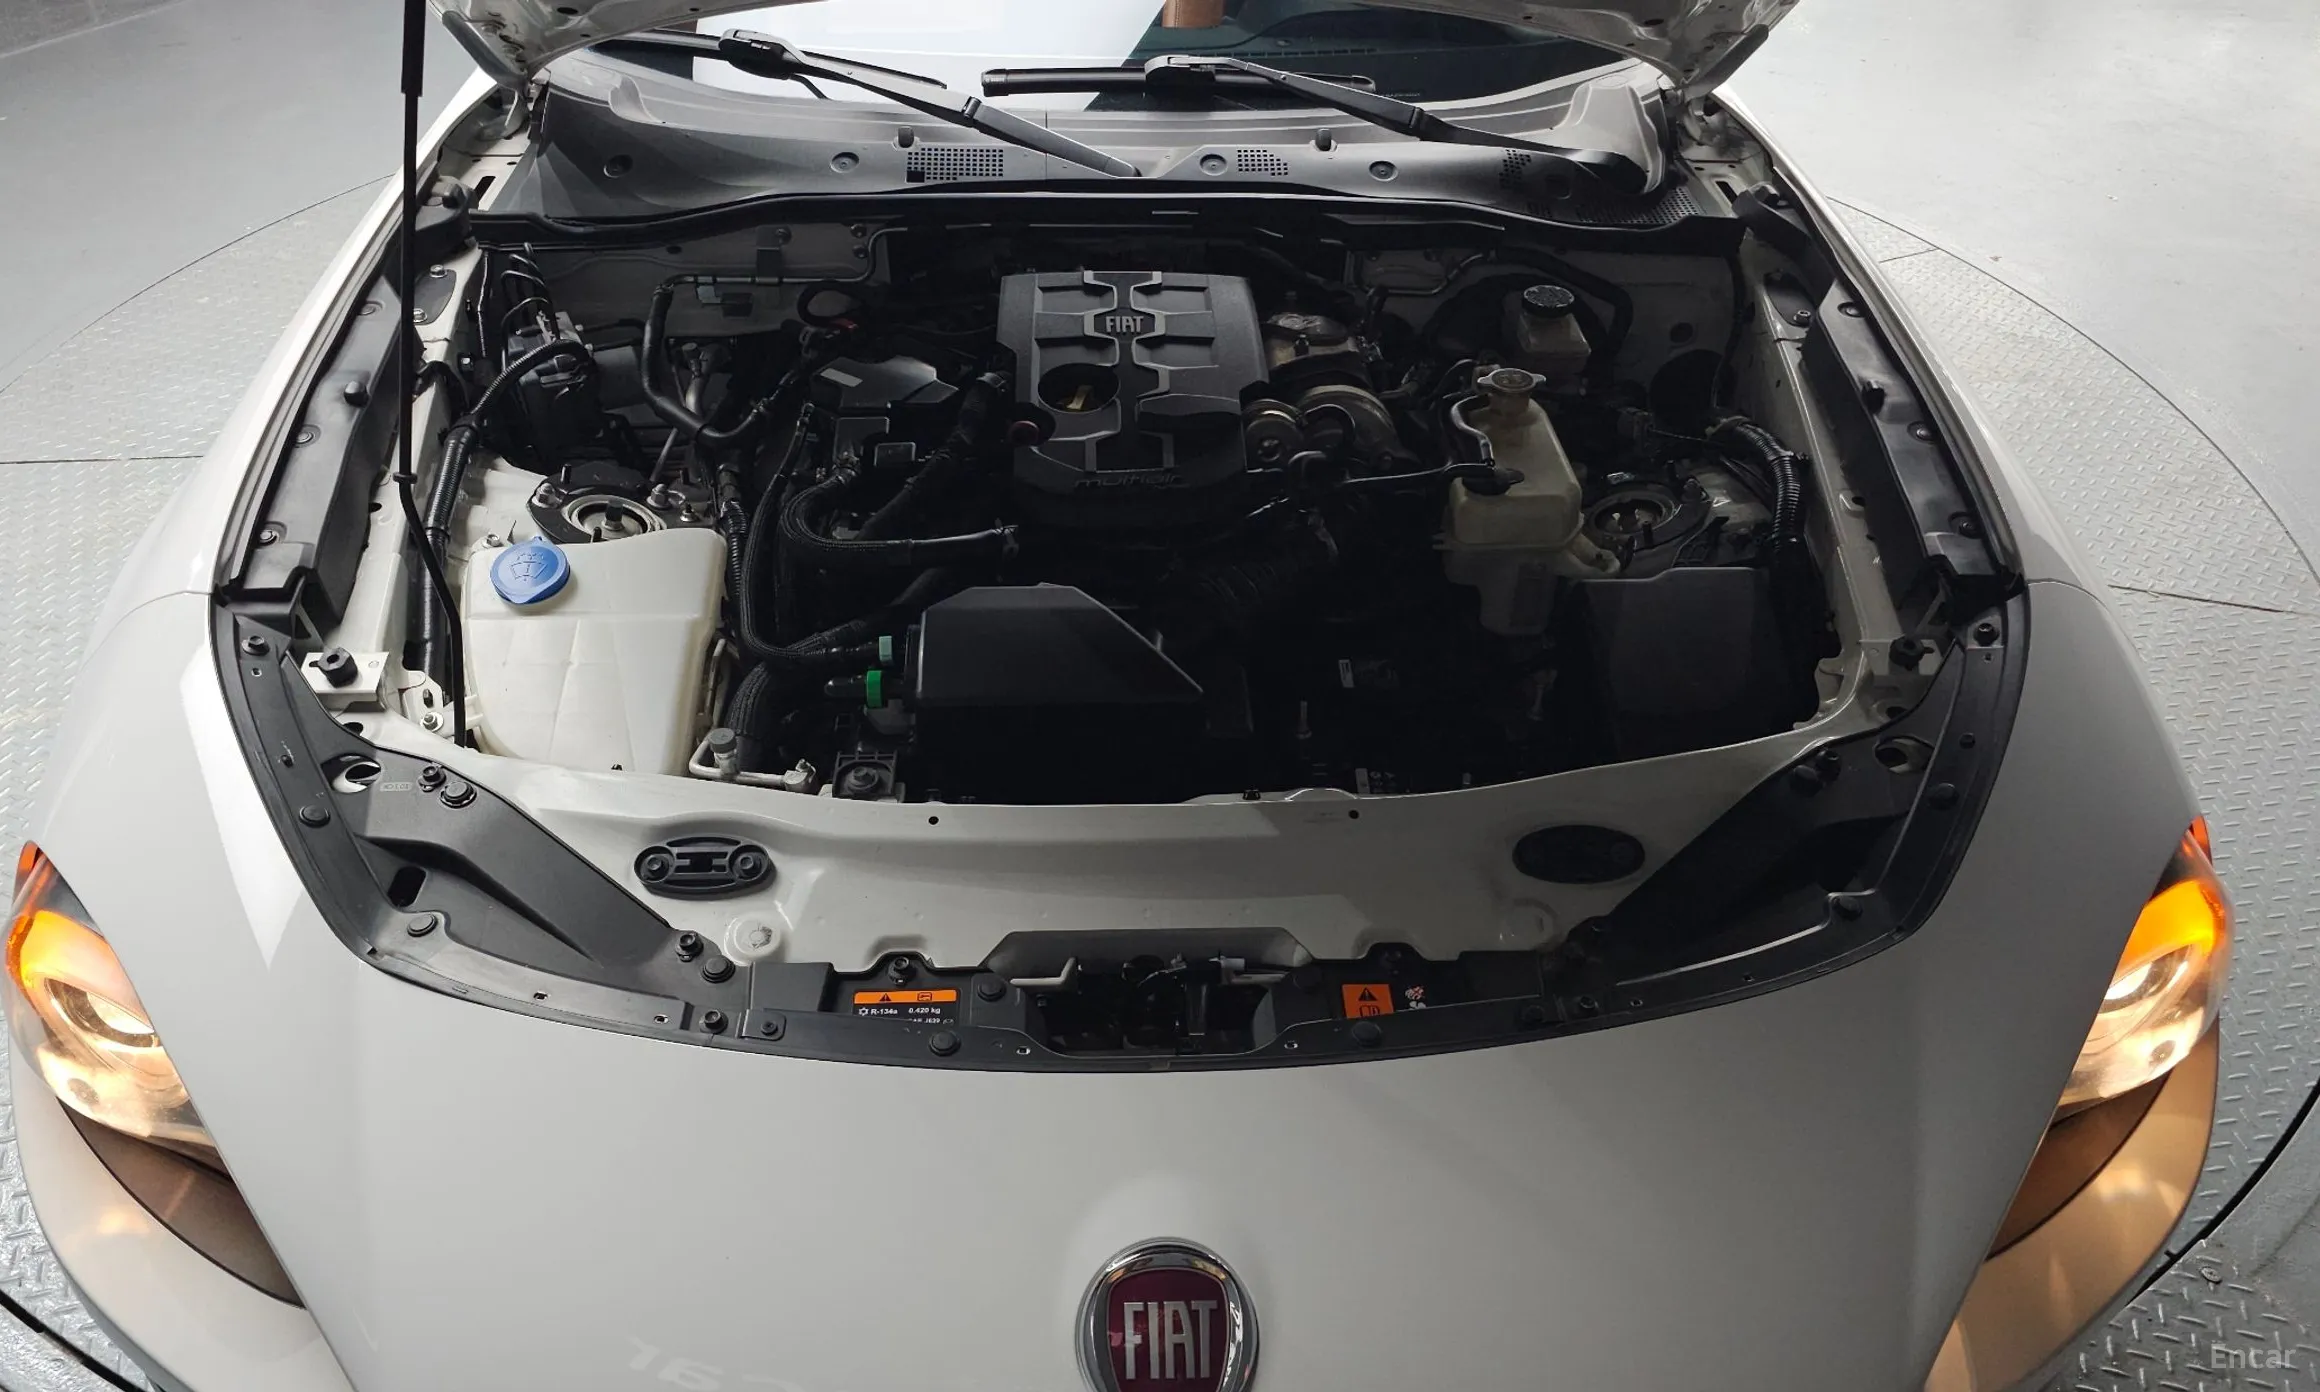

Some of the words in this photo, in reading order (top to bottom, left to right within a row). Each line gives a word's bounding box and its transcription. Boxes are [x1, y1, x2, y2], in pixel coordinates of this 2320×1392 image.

[1105, 315, 1144, 333] FIAT
[931, 1007, 941, 1015] kg
[1123, 1300, 1218, 1380] FIAT
